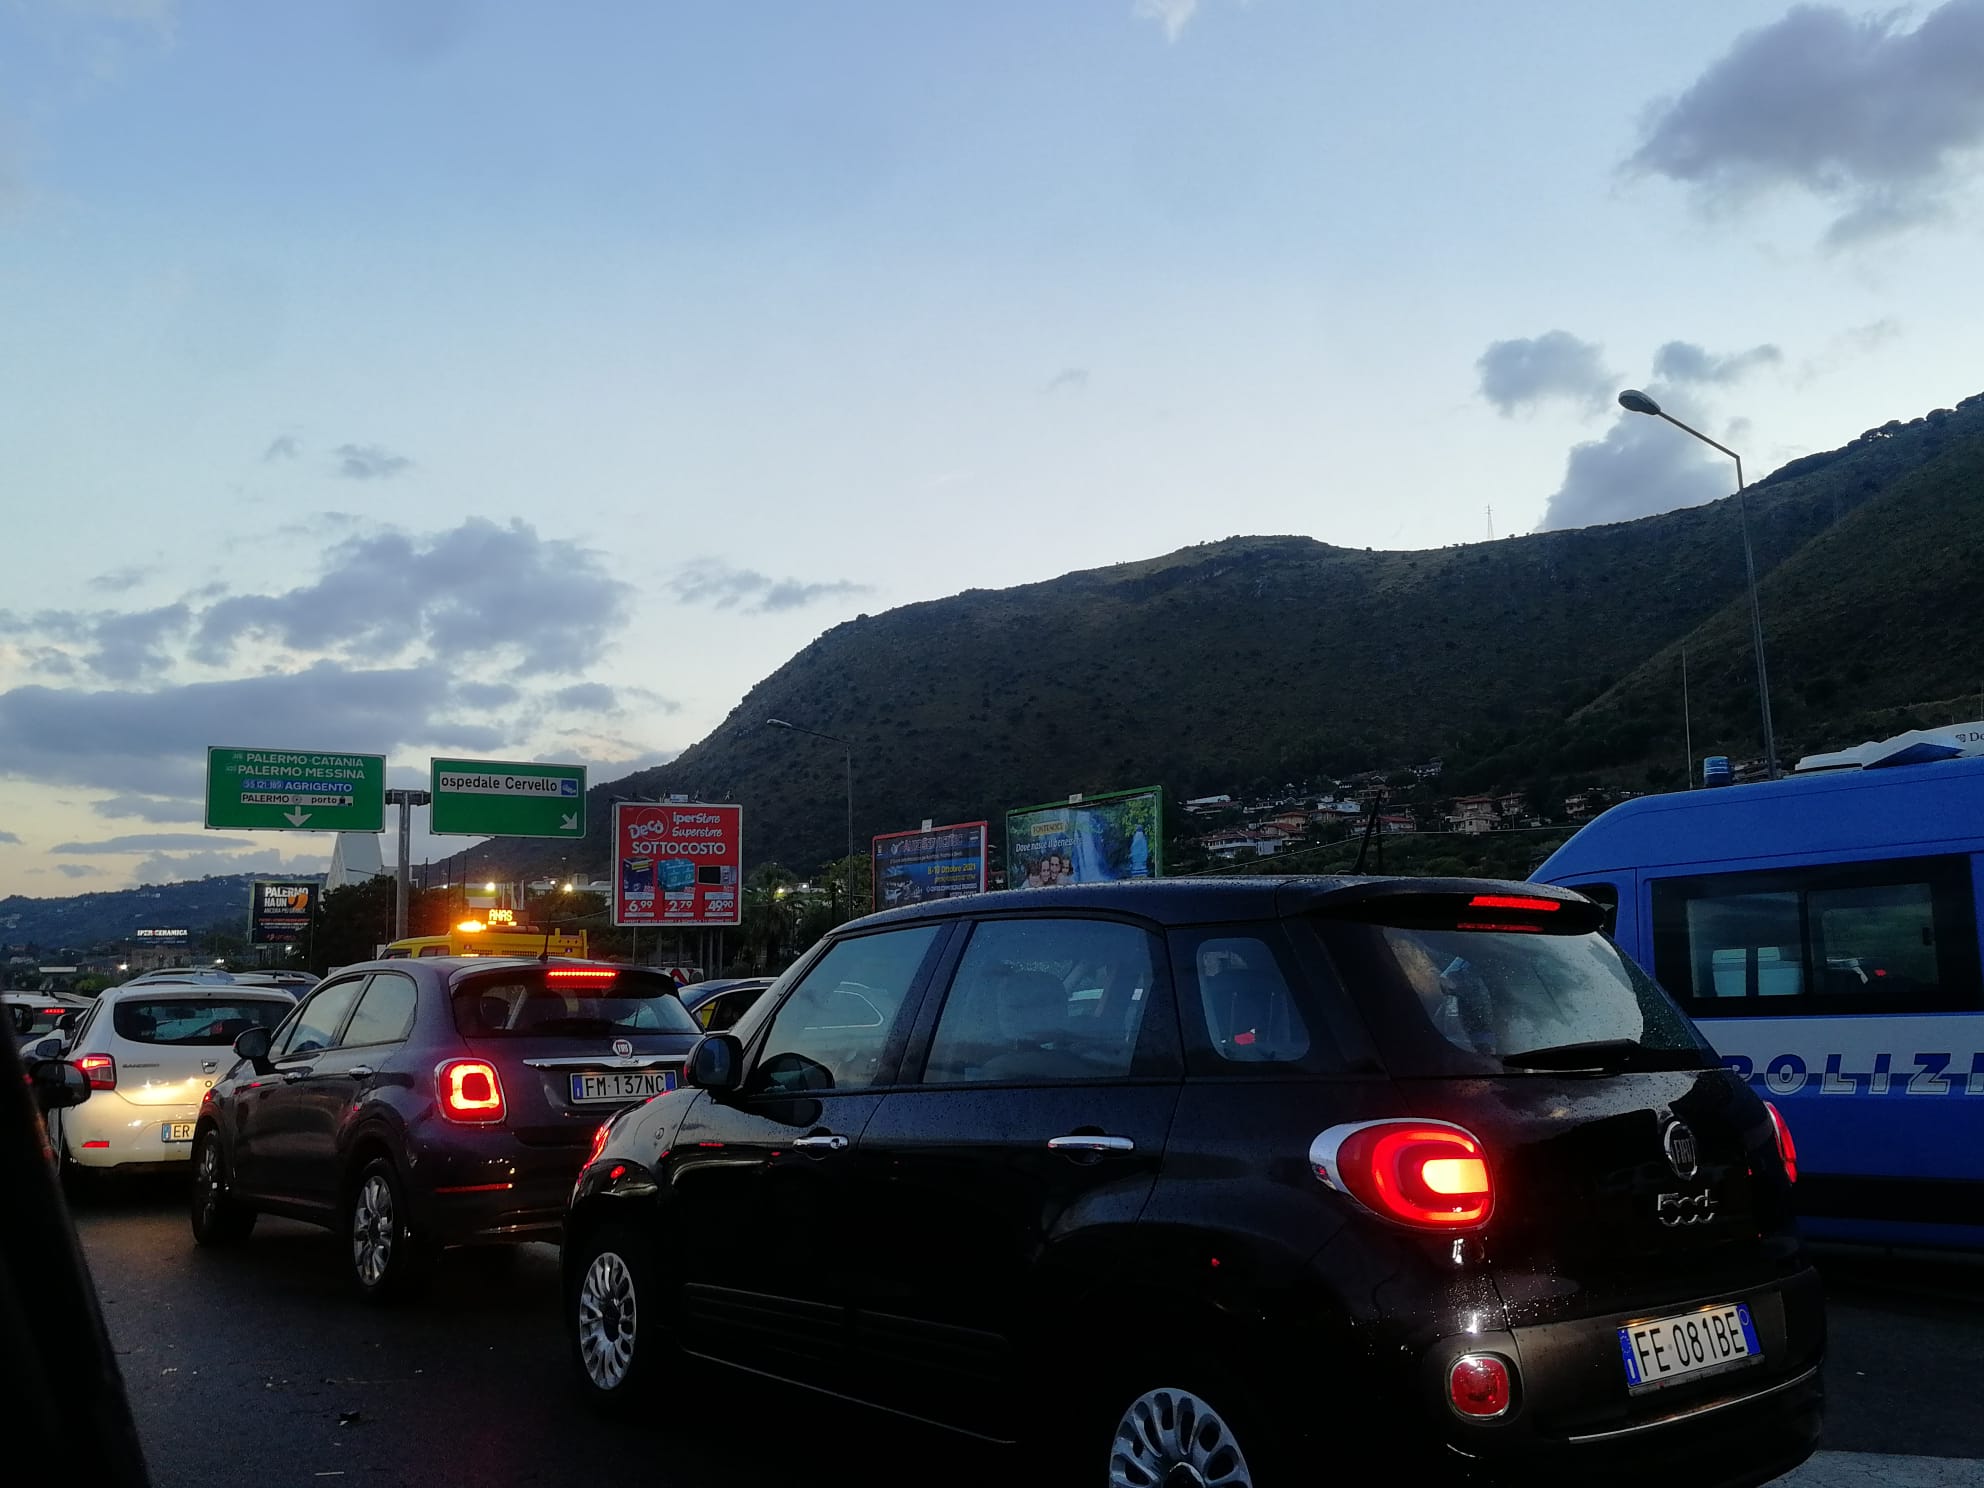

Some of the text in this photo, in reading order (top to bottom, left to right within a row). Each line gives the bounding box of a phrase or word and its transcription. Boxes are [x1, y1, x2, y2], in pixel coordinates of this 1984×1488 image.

[284, 781, 353, 792] AGRIGENTO
[441, 776, 558, 792] ospedale Cervello
[242, 793, 337, 805] PALERMO porto
[631, 841, 726, 855] SOTTOCOSTO
[264, 886, 309, 897] PALERMO
[264, 897, 287, 908] HA UN
[628, 900, 653, 912] 6,99
[668, 900, 693, 912] 2,79
[488, 908, 513, 922] ANAS
[585, 1077, 606, 1097] FM
[614, 1075, 665, 1096] 137NC
[173, 1124, 190, 1138] ER
[1633, 1327, 1671, 1377] FE
[1671, 1311, 1745, 1368] 081BE
